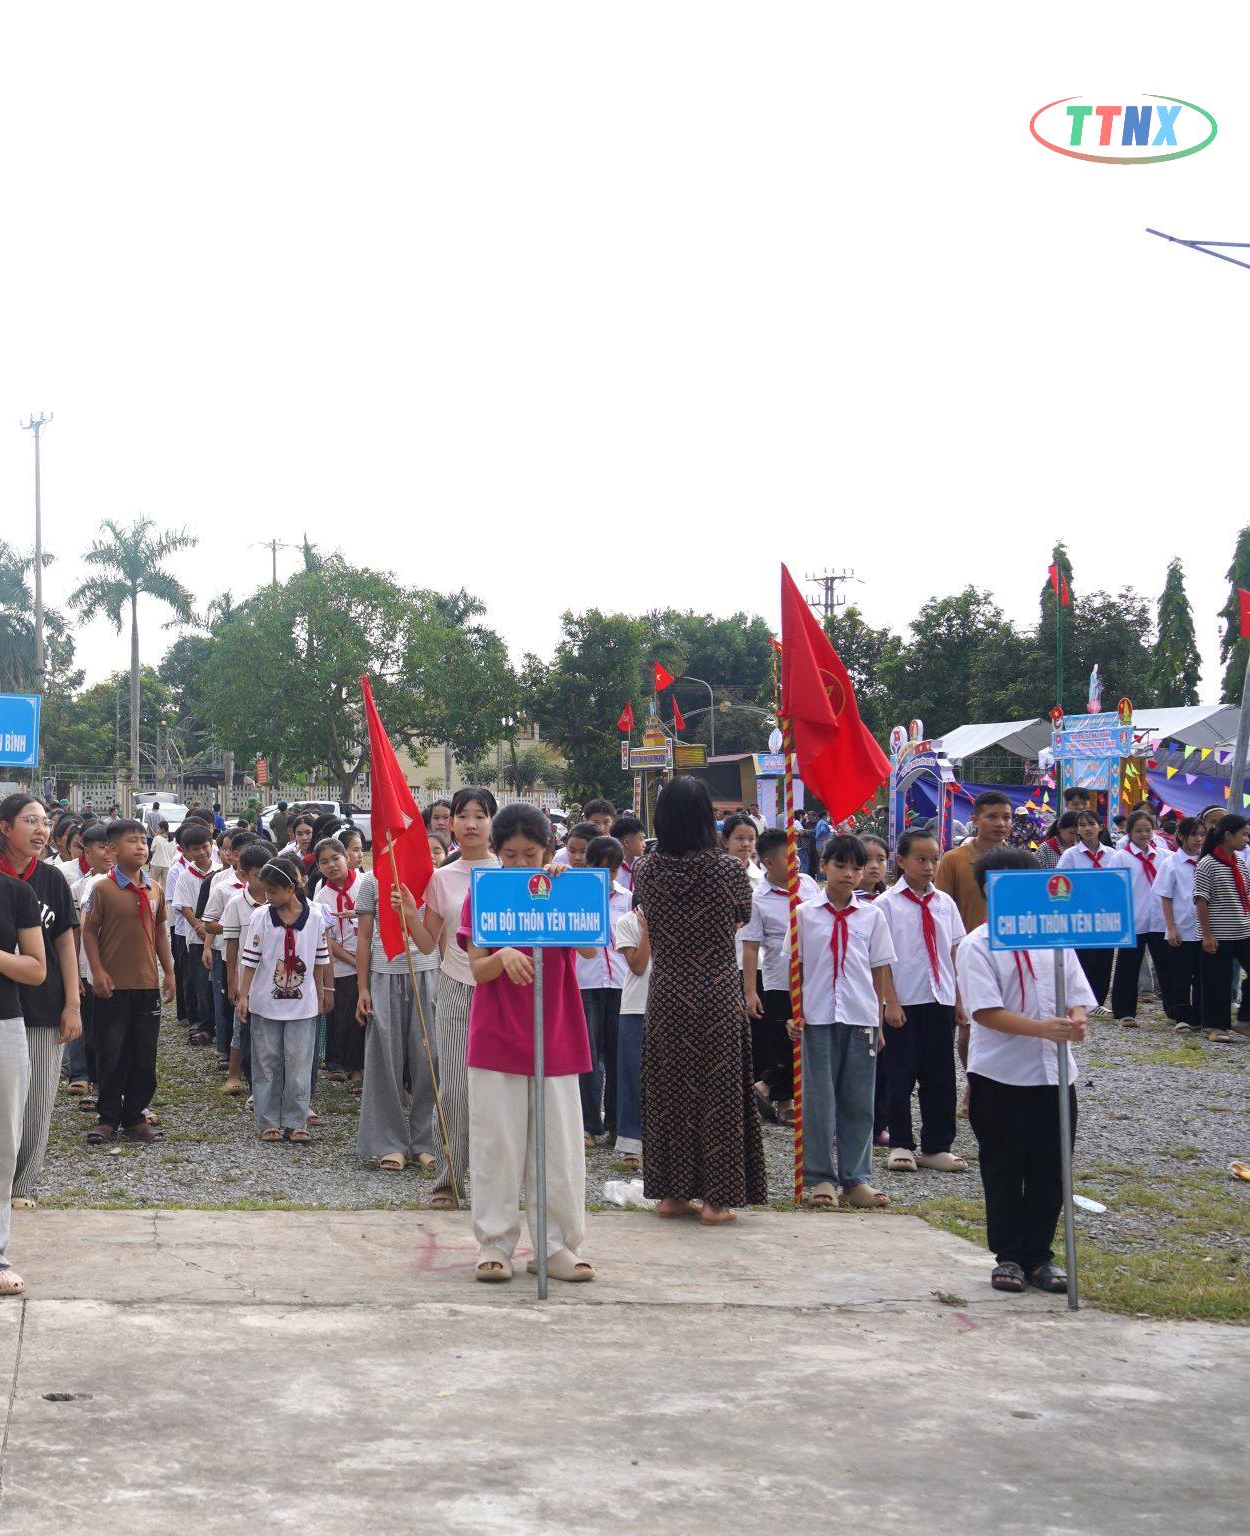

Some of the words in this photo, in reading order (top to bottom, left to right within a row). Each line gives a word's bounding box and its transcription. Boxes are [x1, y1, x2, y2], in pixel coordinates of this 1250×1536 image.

[5, 730, 27, 752] BÌNH
[481, 911, 497, 931] CHI
[499, 908, 515, 935] ĐỘI
[518, 908, 544, 931] THÔN
[546, 908, 566, 931] YÊN
[568, 908, 600, 931] THÀNH
[997, 915, 1017, 935] CHI
[1018, 910, 1037, 939] ĐỘI
[1039, 909, 1068, 934] THÔN
[1070, 909, 1092, 933] YÊN
[1094, 908, 1122, 933] BÌNH
